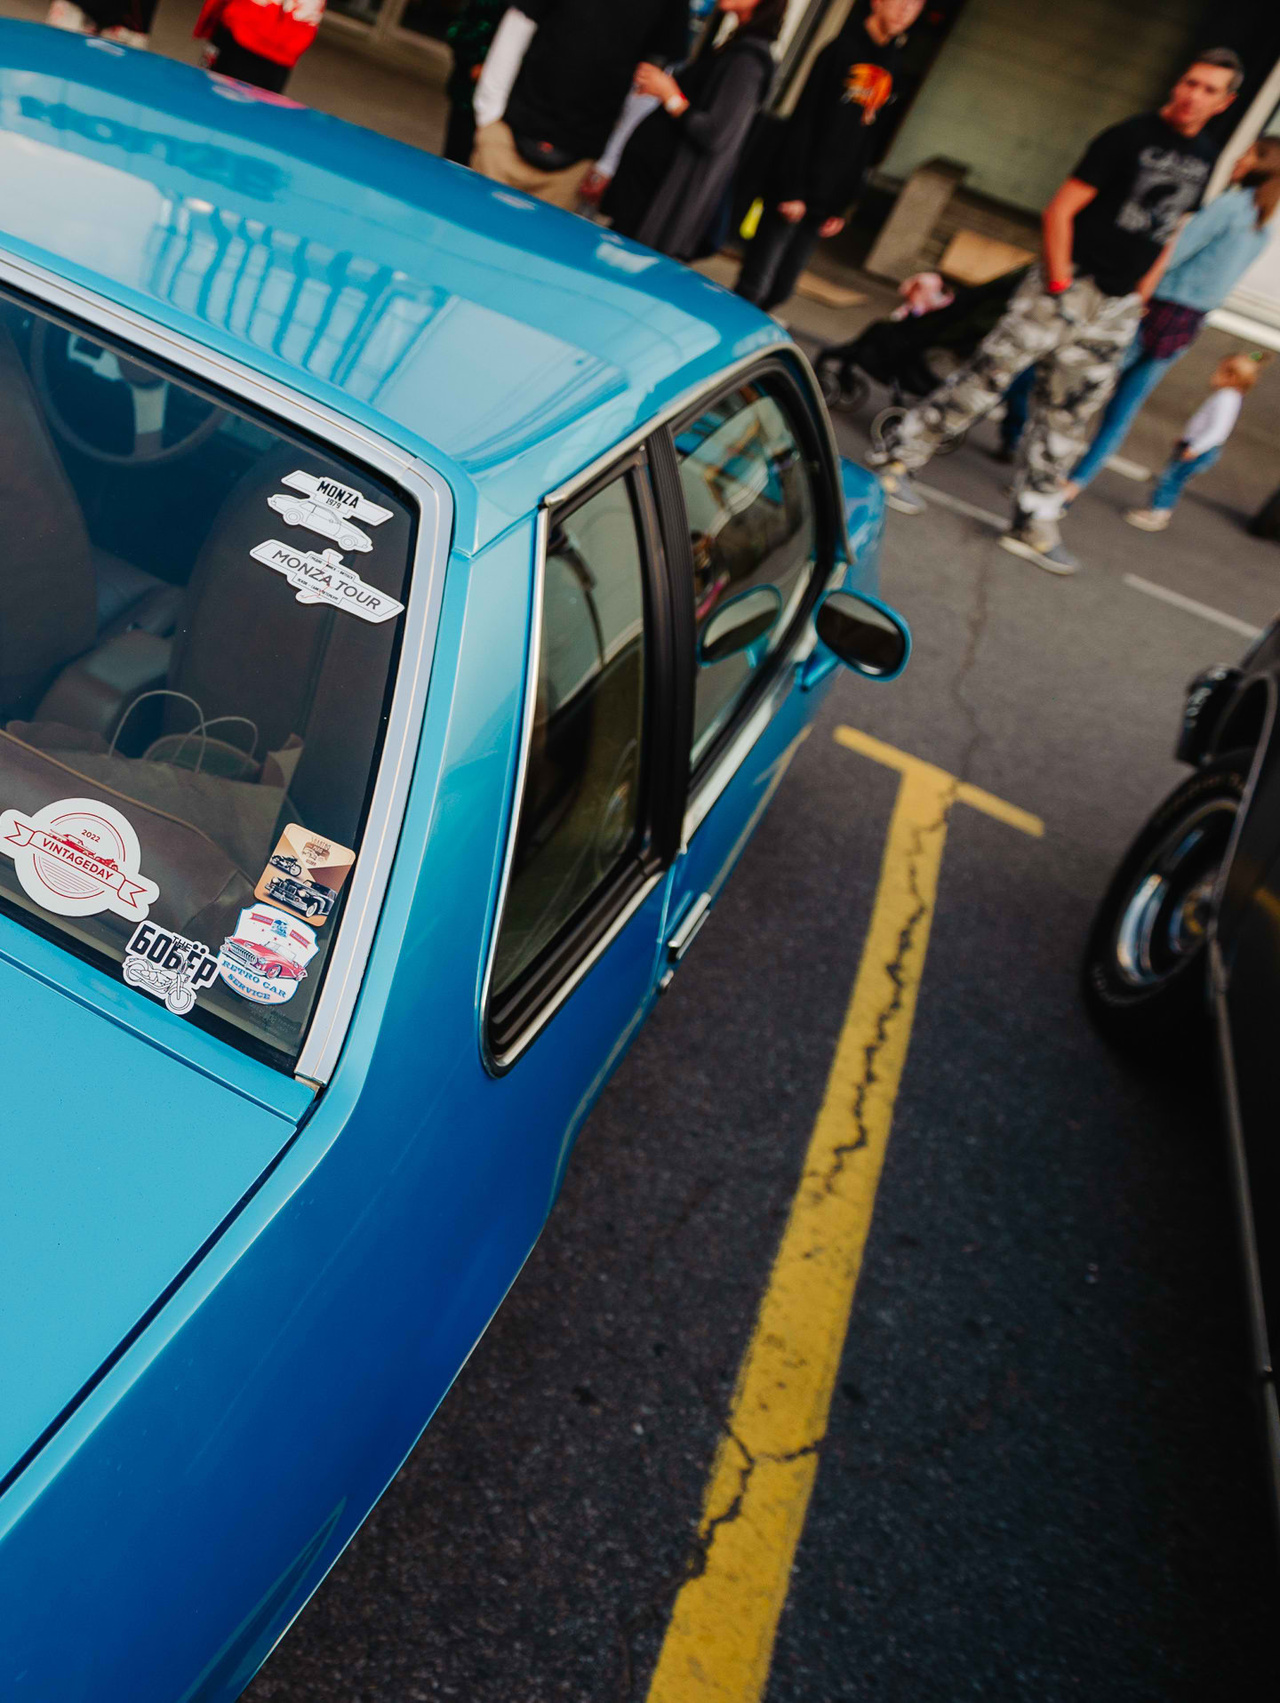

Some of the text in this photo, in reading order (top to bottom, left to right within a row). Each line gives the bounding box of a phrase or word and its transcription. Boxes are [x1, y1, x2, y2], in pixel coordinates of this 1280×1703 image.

[317, 480, 360, 508] MONZA
[325, 498, 342, 509] 1979
[272, 550, 332, 586] MONZA
[334, 580, 381, 610] TOUR
[81, 829, 100, 844] 2022
[42, 838, 114, 881] VINTAGEDAY
[172, 936, 193, 953] THE
[221, 959, 287, 998] RETRO CAR
[228, 973, 271, 1000] SERVICE
